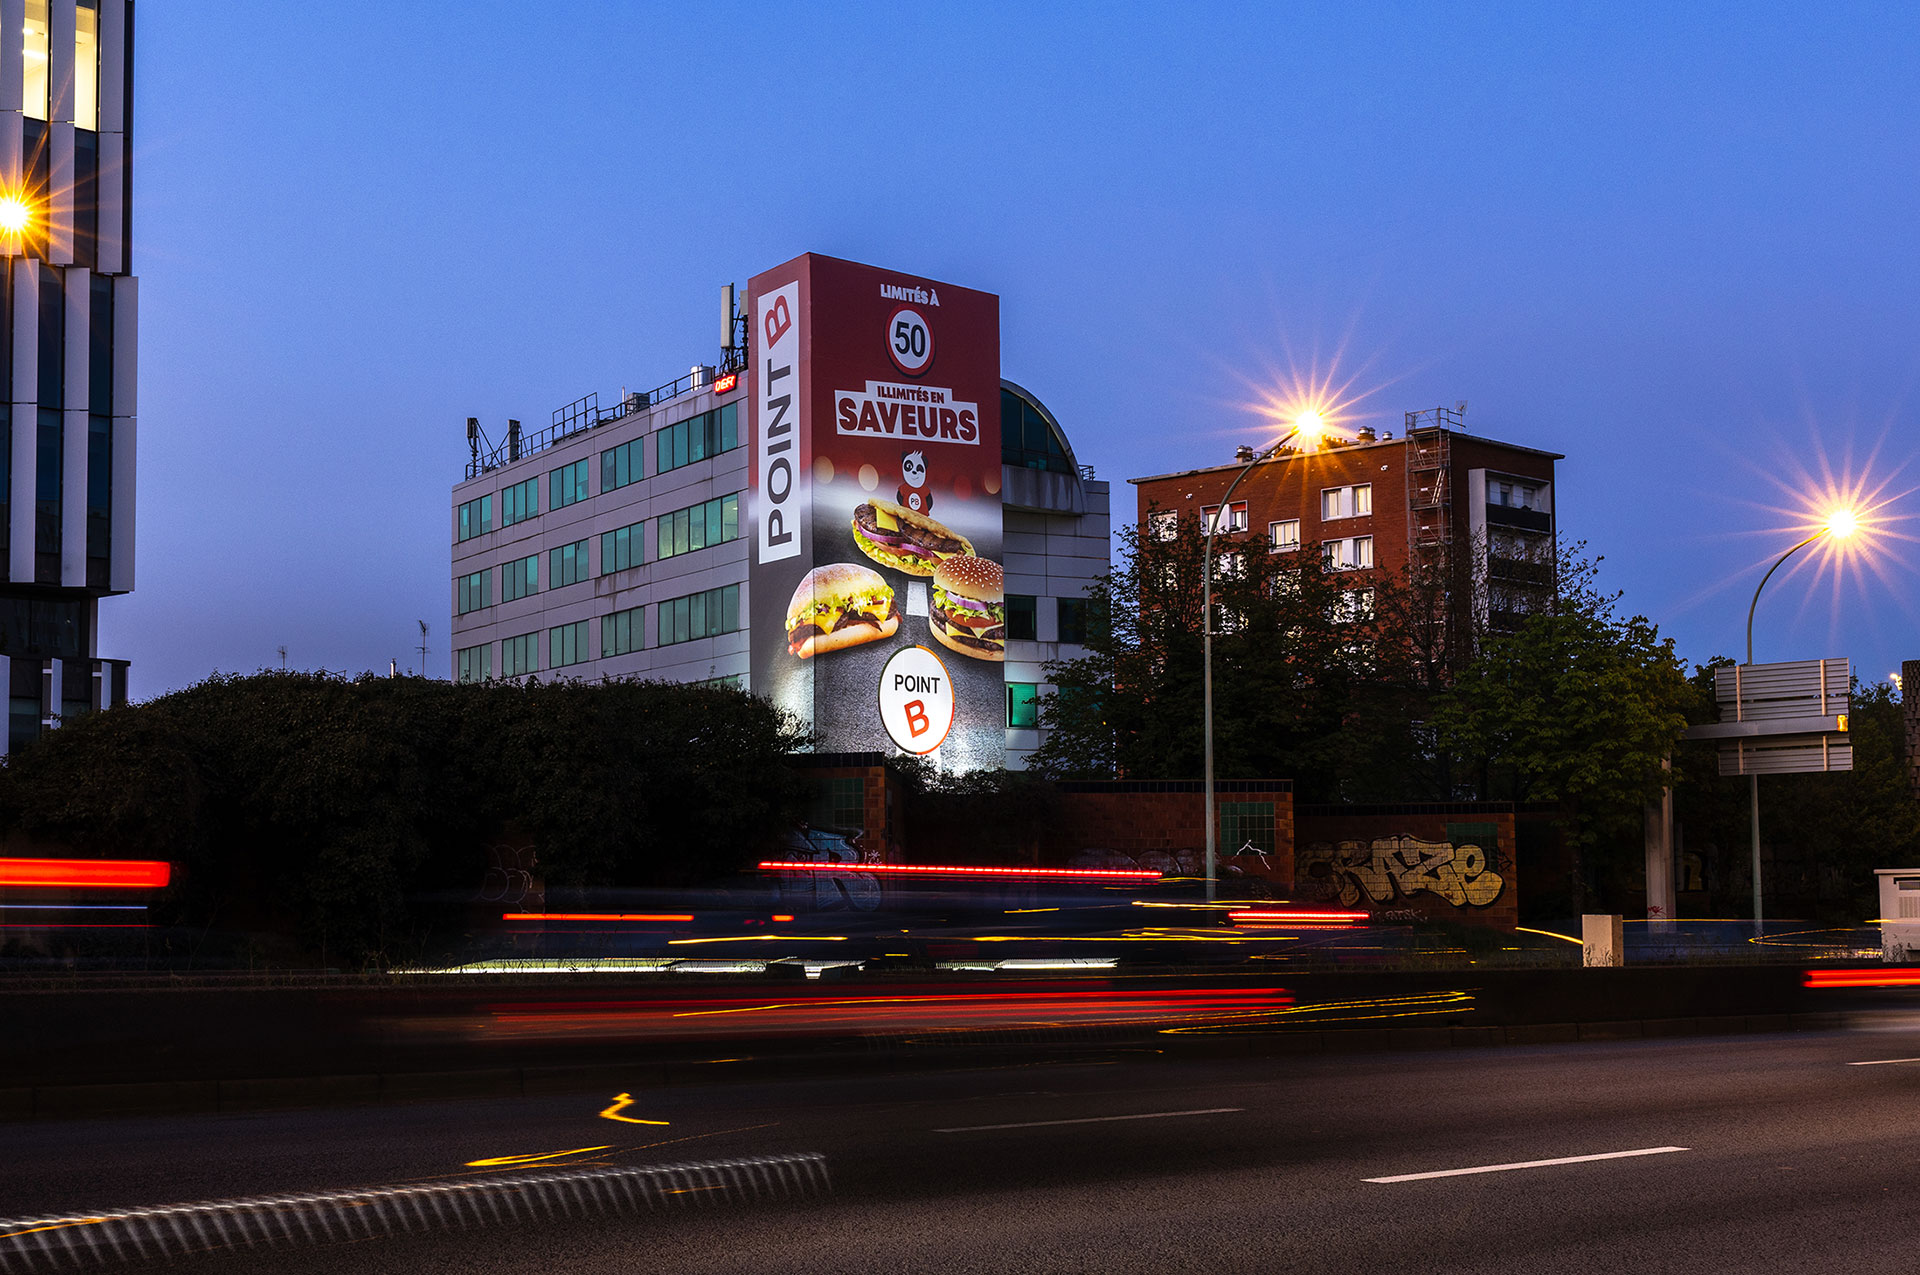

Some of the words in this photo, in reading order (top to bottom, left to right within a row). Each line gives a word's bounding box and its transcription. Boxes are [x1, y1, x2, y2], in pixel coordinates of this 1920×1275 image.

[880, 283, 928, 305] LIMITÉS
[929, 288, 940, 307] À
[764, 294, 792, 350] B
[894, 321, 926, 358] 50
[877, 385, 929, 402] ILLIMITÉS
[930, 391, 944, 404] EN
[838, 397, 977, 441] SAVEURS
[767, 358, 792, 547] POINT
[910, 497, 920, 506] PB
[894, 673, 940, 694] POINT
[903, 699, 930, 738] B
